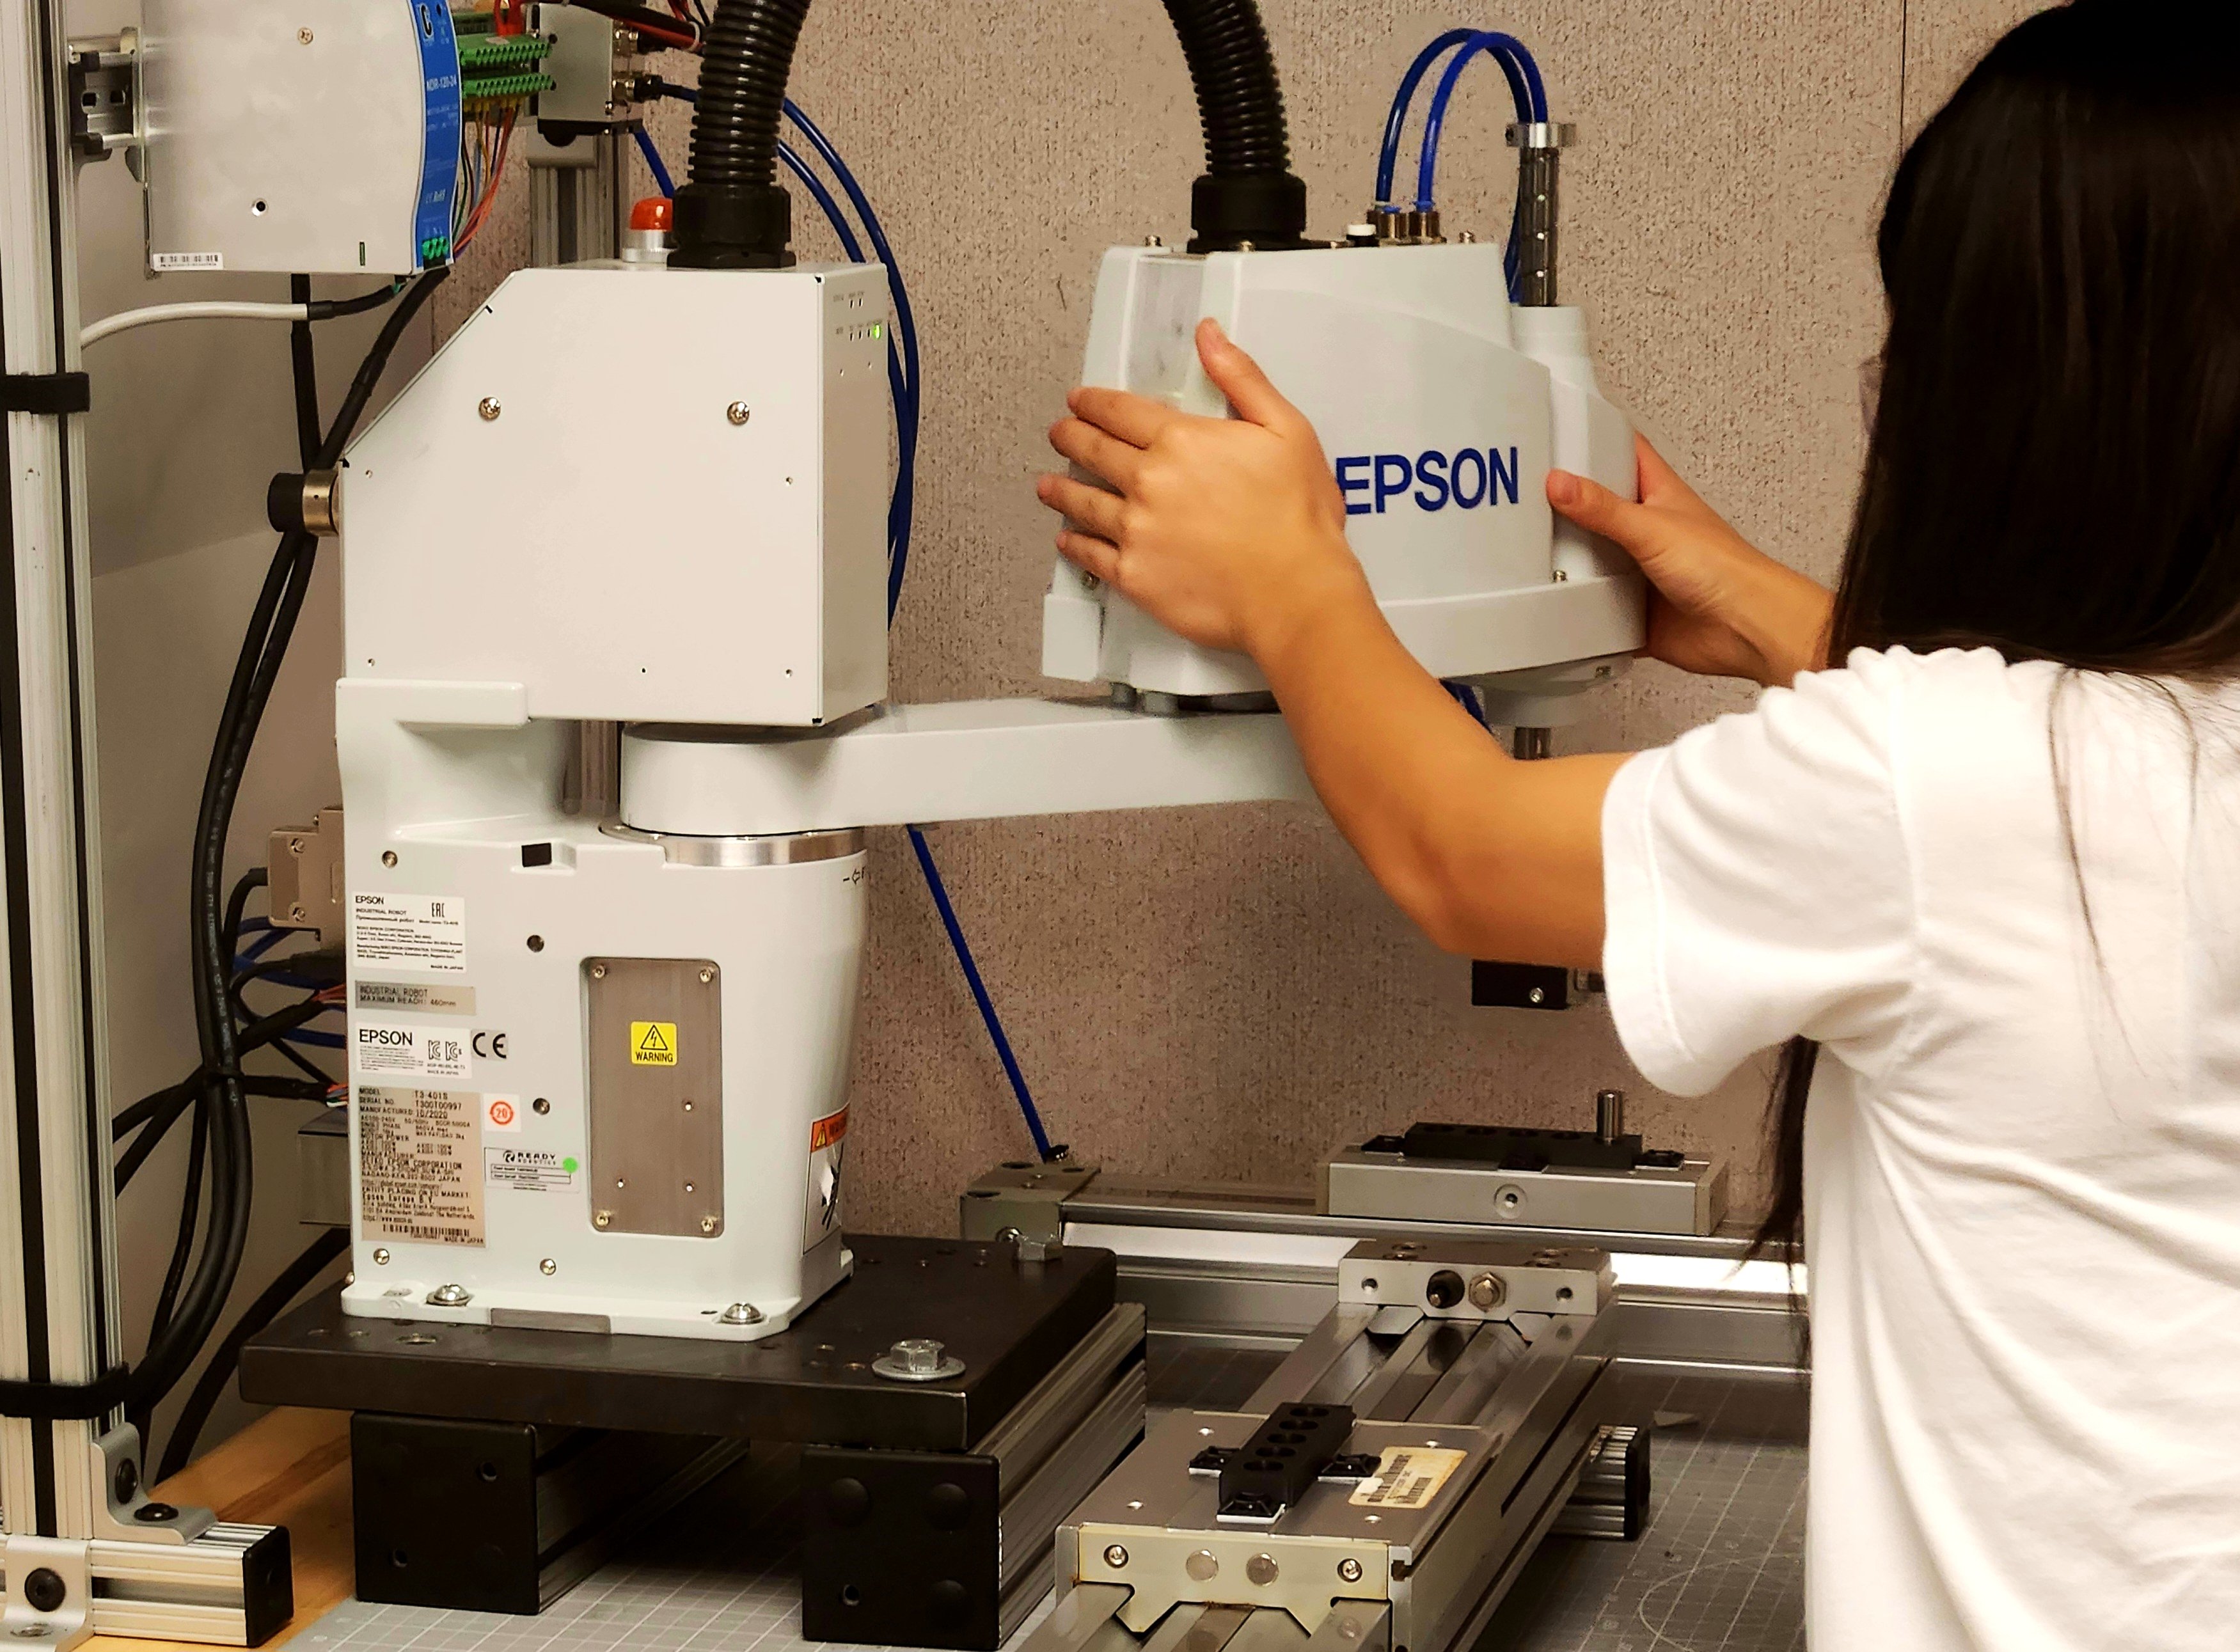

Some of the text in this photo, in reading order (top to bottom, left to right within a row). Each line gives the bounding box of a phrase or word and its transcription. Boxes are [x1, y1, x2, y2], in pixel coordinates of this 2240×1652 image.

[1336, 446, 1519, 515] EPSON
[356, 895, 384, 904] EPSON
[360, 986, 428, 997] INDUSTRIAL ROBOT
[360, 995, 395, 1003] MAXIMUM
[359, 1028, 413, 1046] EPSON
[636, 1051, 673, 1062] WARNING
[359, 1096, 381, 1105] SERIAL
[416, 1109, 448, 1119] 10/2020
[496, 1108, 508, 1119] 20
[413, 1160, 462, 1170] CORPORATION
[388, 1194, 414, 1204] Europe
